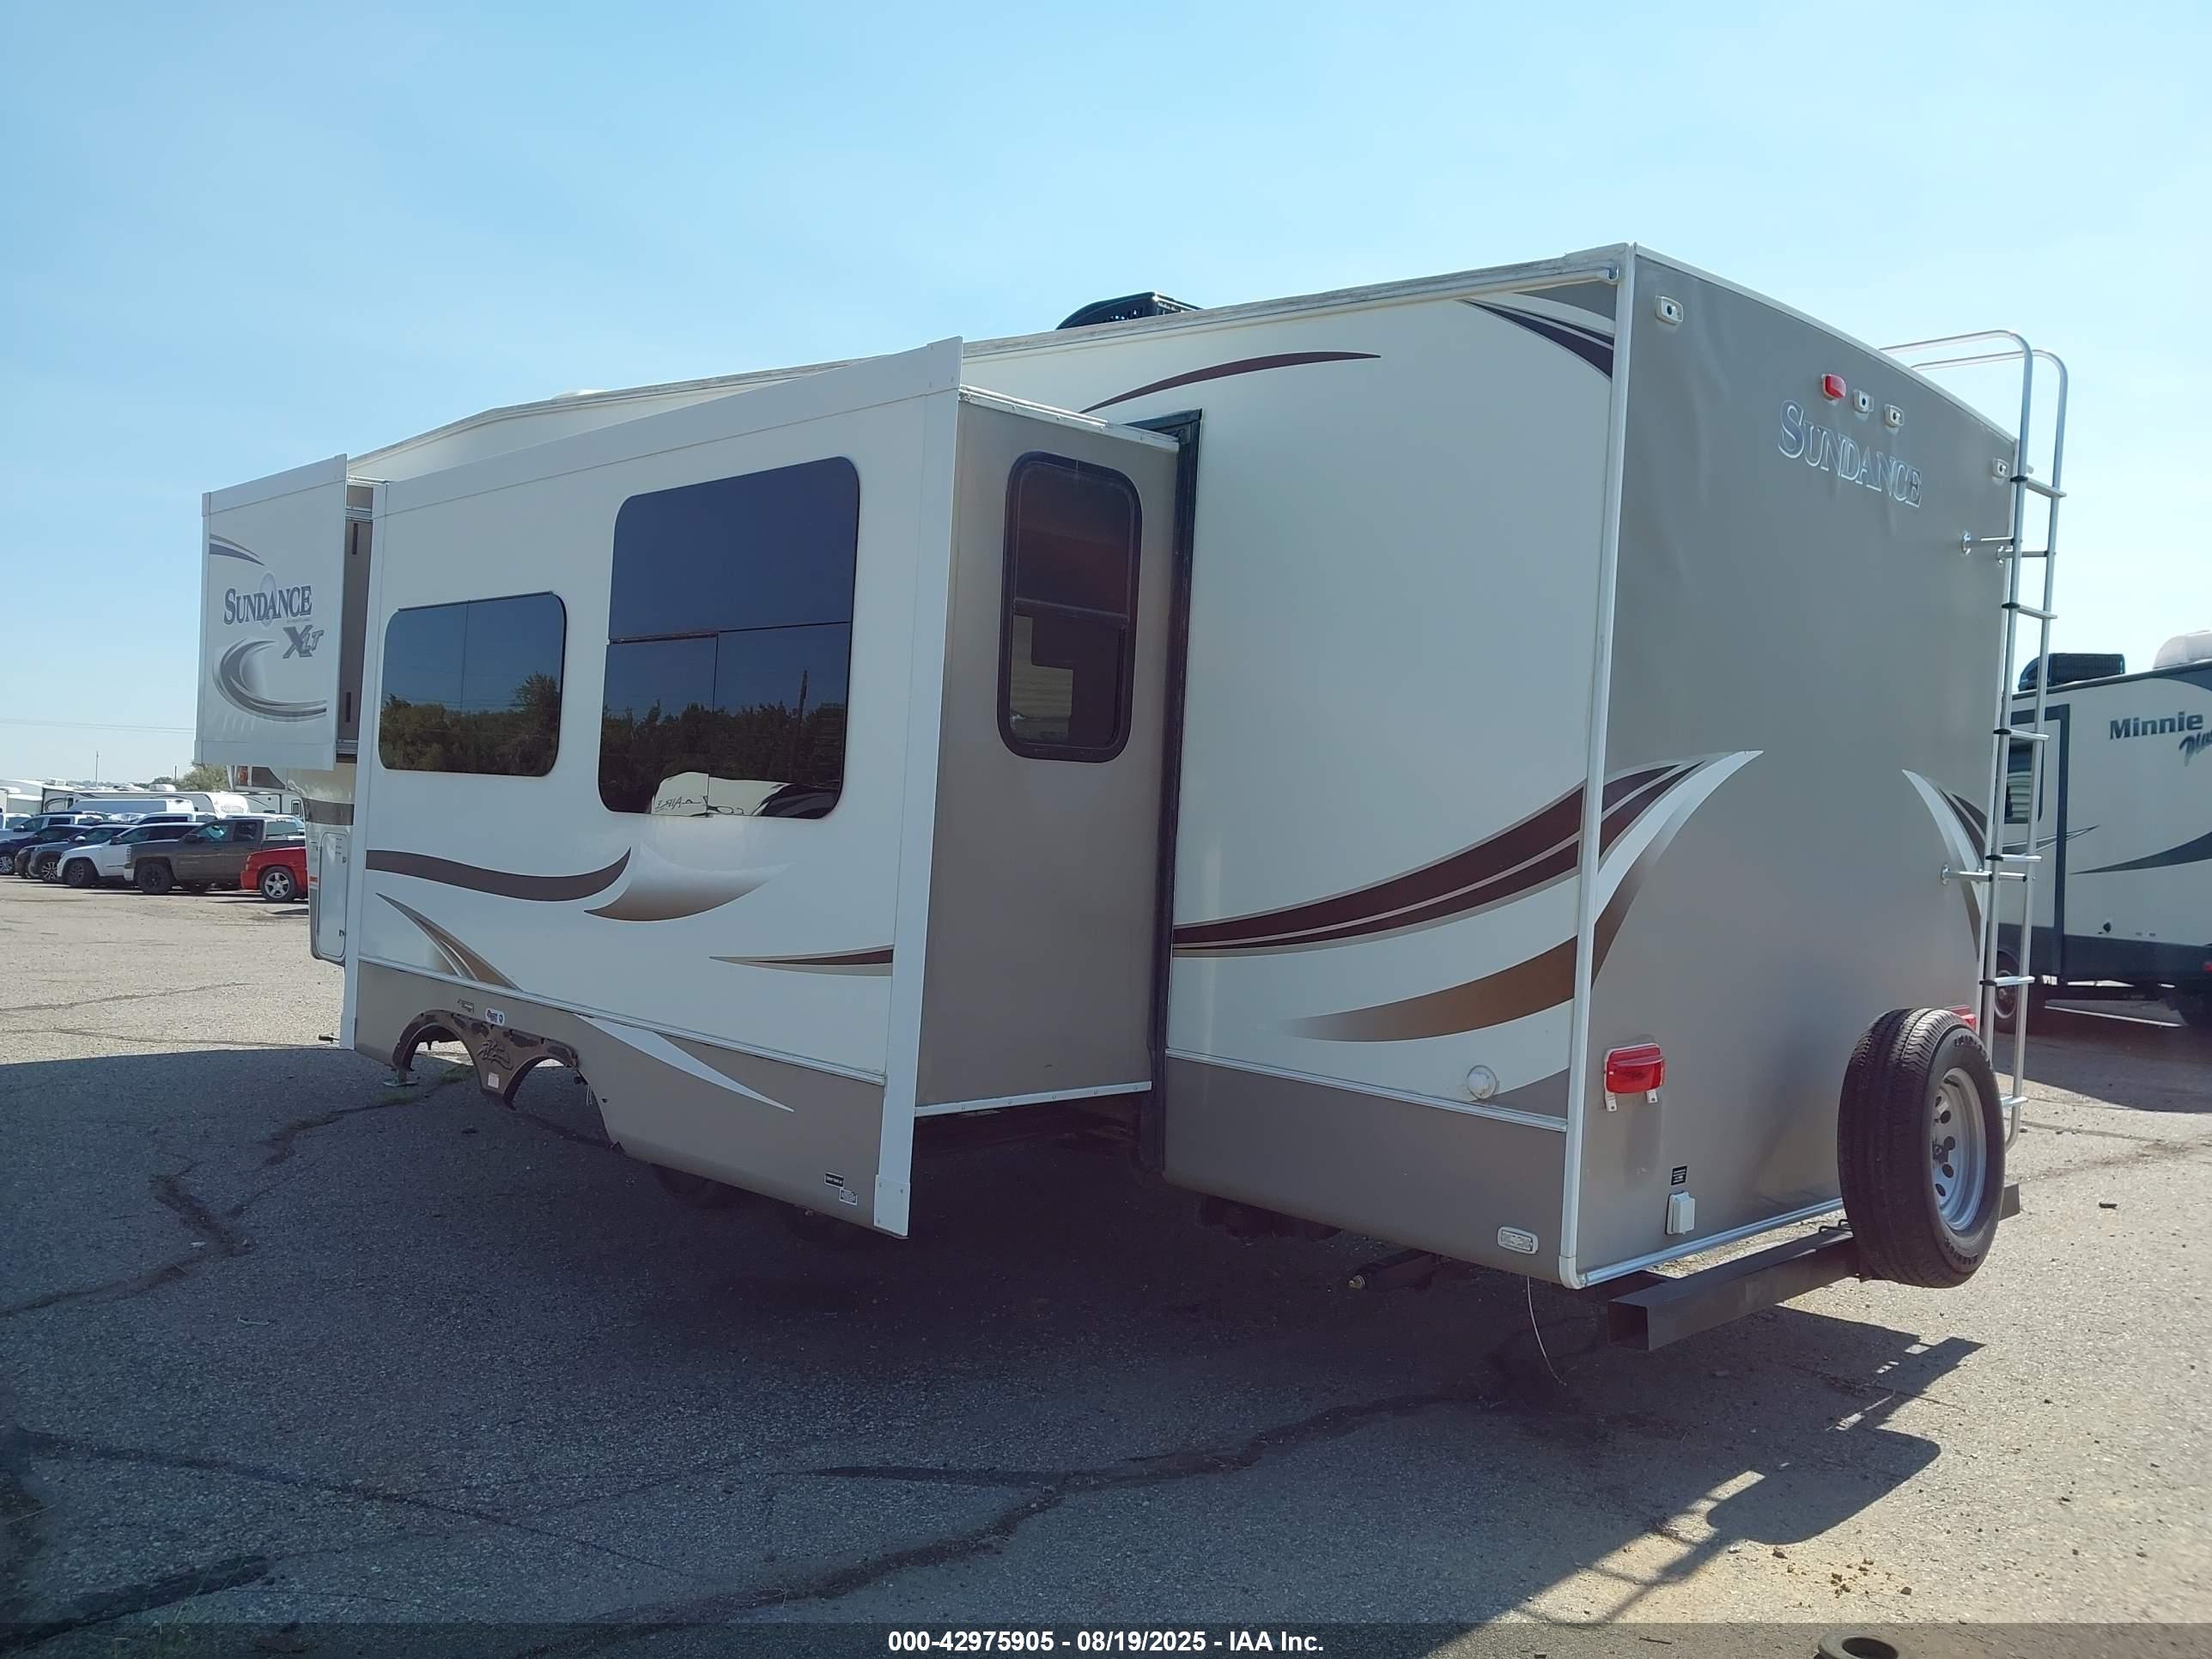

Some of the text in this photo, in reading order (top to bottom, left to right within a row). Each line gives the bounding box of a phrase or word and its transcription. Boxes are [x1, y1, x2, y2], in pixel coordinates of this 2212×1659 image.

[1778, 399, 1923, 508] SUNDANCE
[223, 585, 313, 625] SUNDANCE
[283, 624, 325, 659] XLT
[2110, 711, 2203, 740] Minnie
